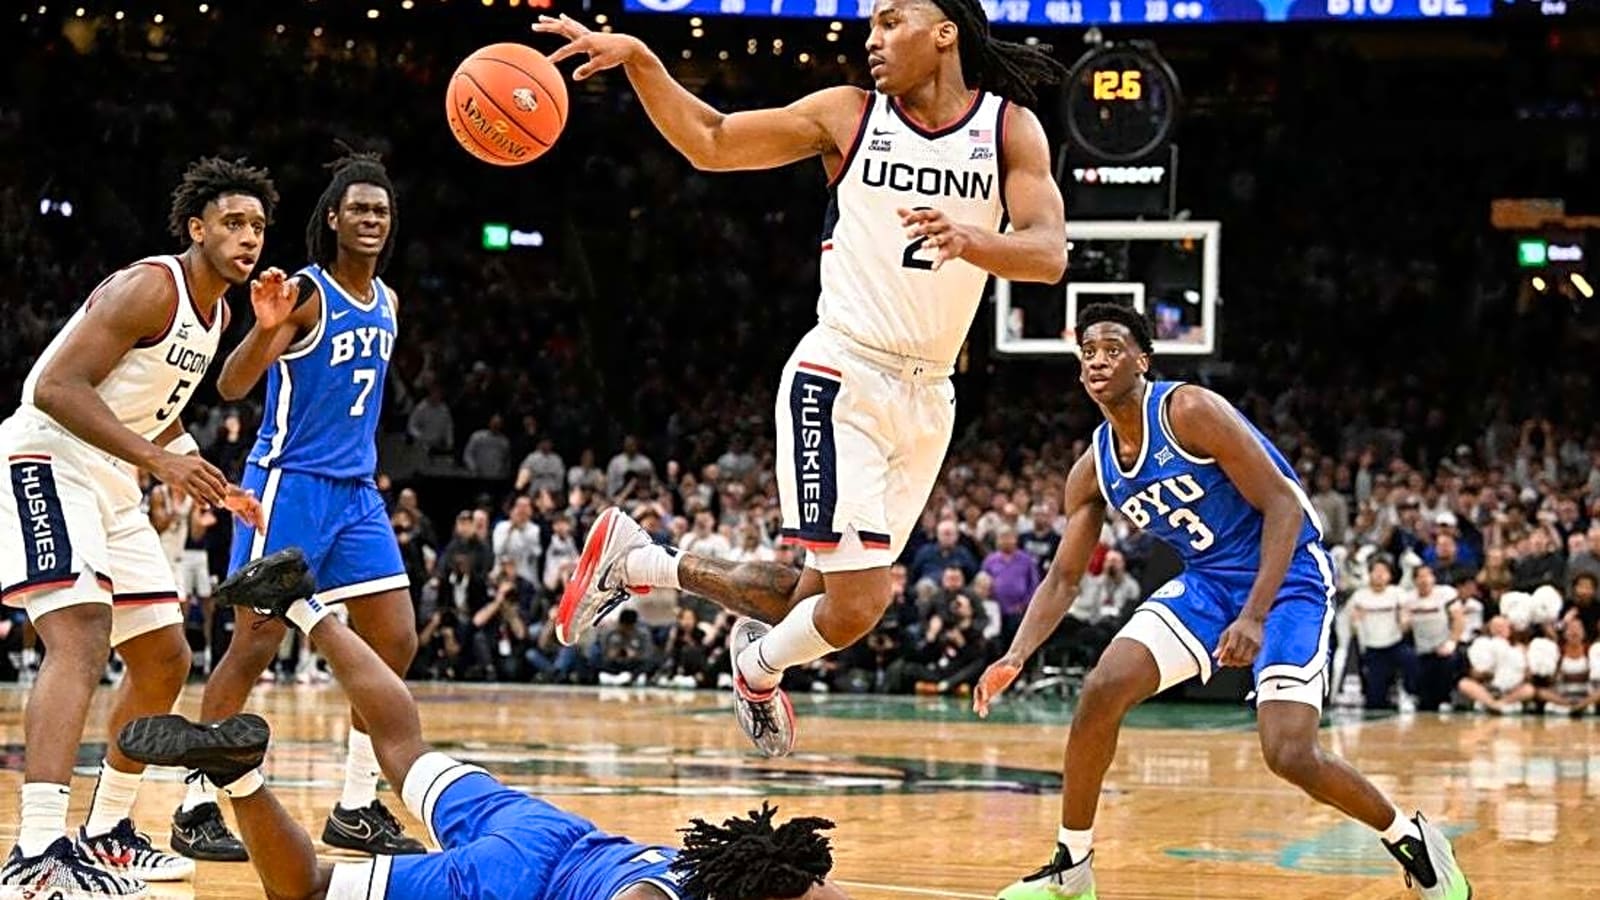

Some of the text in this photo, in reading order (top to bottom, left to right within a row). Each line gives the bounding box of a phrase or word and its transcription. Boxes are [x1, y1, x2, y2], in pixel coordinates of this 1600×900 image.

[862, 158, 993, 200] UCONN
[330, 326, 394, 367] BYU
[156, 379, 191, 420] 5
[349, 368, 376, 416] 7
[802, 383, 822, 523] HUSKIES
[21, 465, 56, 571] HUSKIES
[1120, 474, 1205, 529] BYU
[1168, 508, 1214, 551] 3
